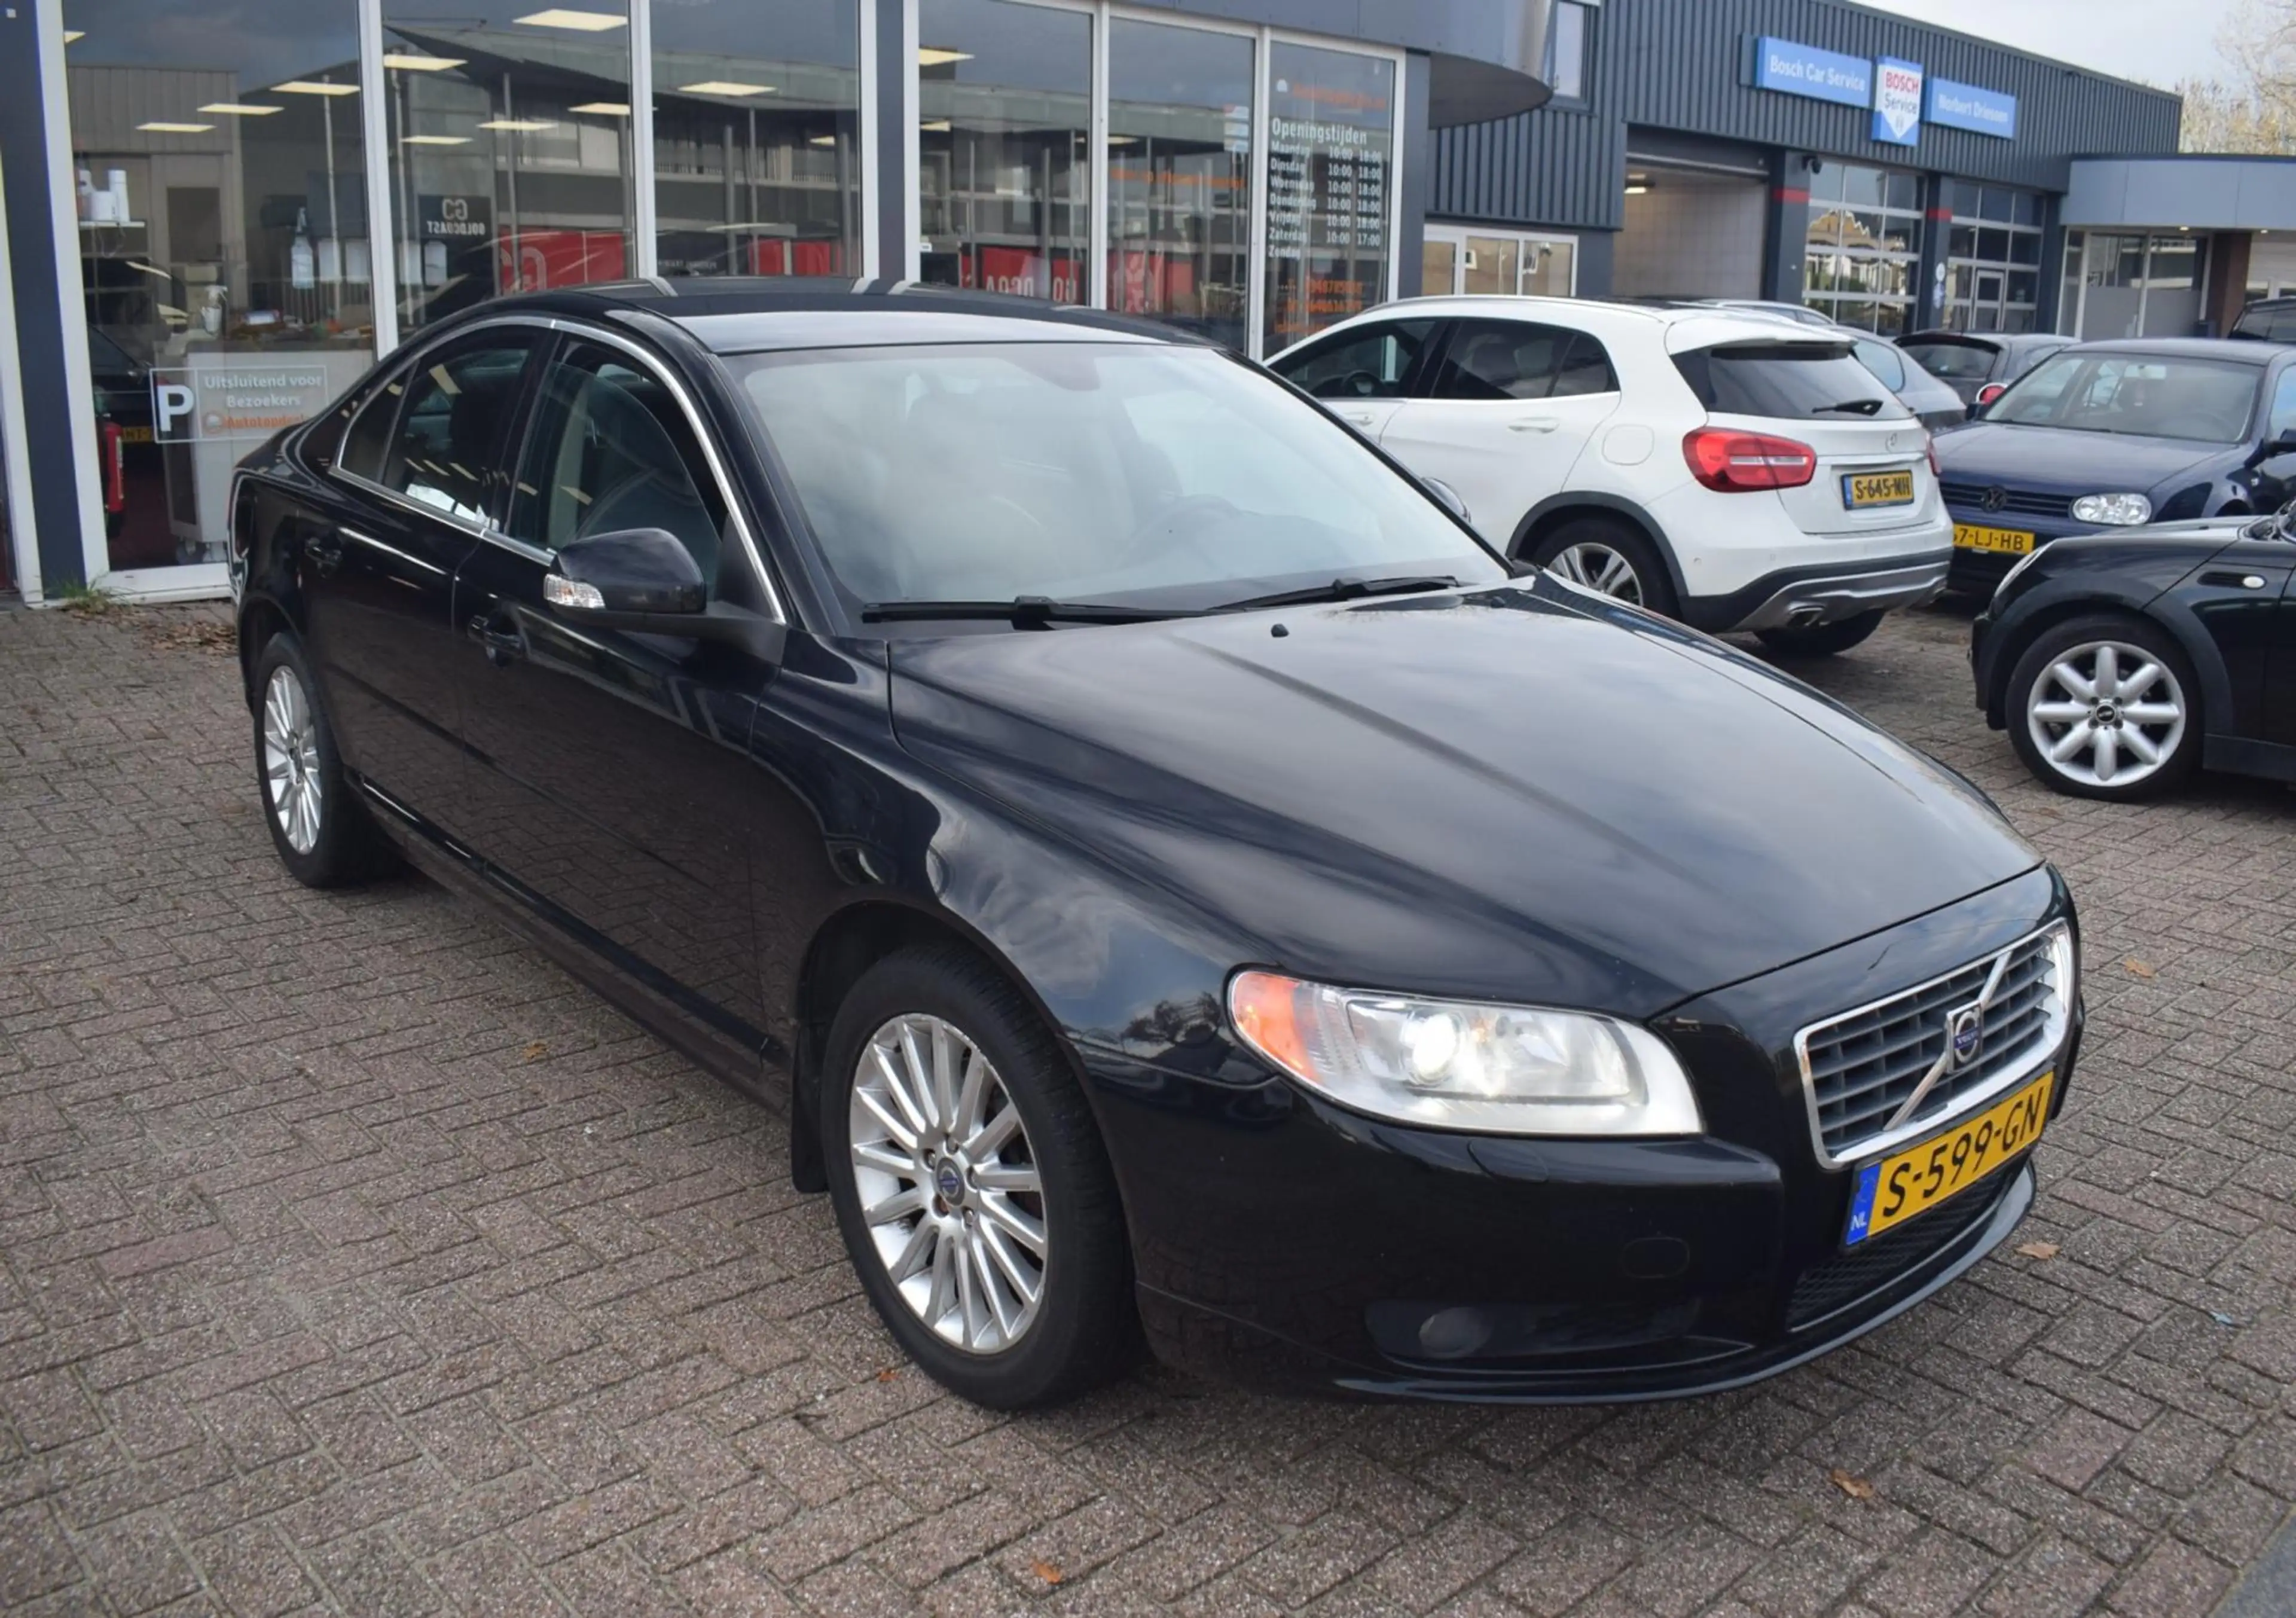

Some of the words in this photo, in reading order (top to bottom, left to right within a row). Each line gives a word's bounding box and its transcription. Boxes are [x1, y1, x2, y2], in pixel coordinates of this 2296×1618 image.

[1770, 54, 1805, 78] Bosch
[1806, 62, 1825, 83] Car
[1827, 67, 1866, 92] Service
[1886, 71, 1919, 95] BOSCH
[1885, 93, 1918, 114] Service
[1272, 117, 1367, 146] Openingstijden
[1270, 157, 1307, 175] Dinsdag
[1328, 163, 1352, 177] 10:00
[1327, 180, 1352, 194] 10:00
[1327, 197, 1351, 210] 10:00
[1326, 214, 1351, 227] 10:00
[1326, 231, 1351, 245] 10:00
[1357, 233, 1380, 246] 17:00
[204, 374, 286, 389] Uitsluitend
[289, 374, 323, 387] voor
[157, 384, 194, 432] P
[227, 394, 301, 408] Bezoekers
[1882, 1085, 2047, 1219] S-599-GN
[1850, 1211, 1867, 1232] NL
